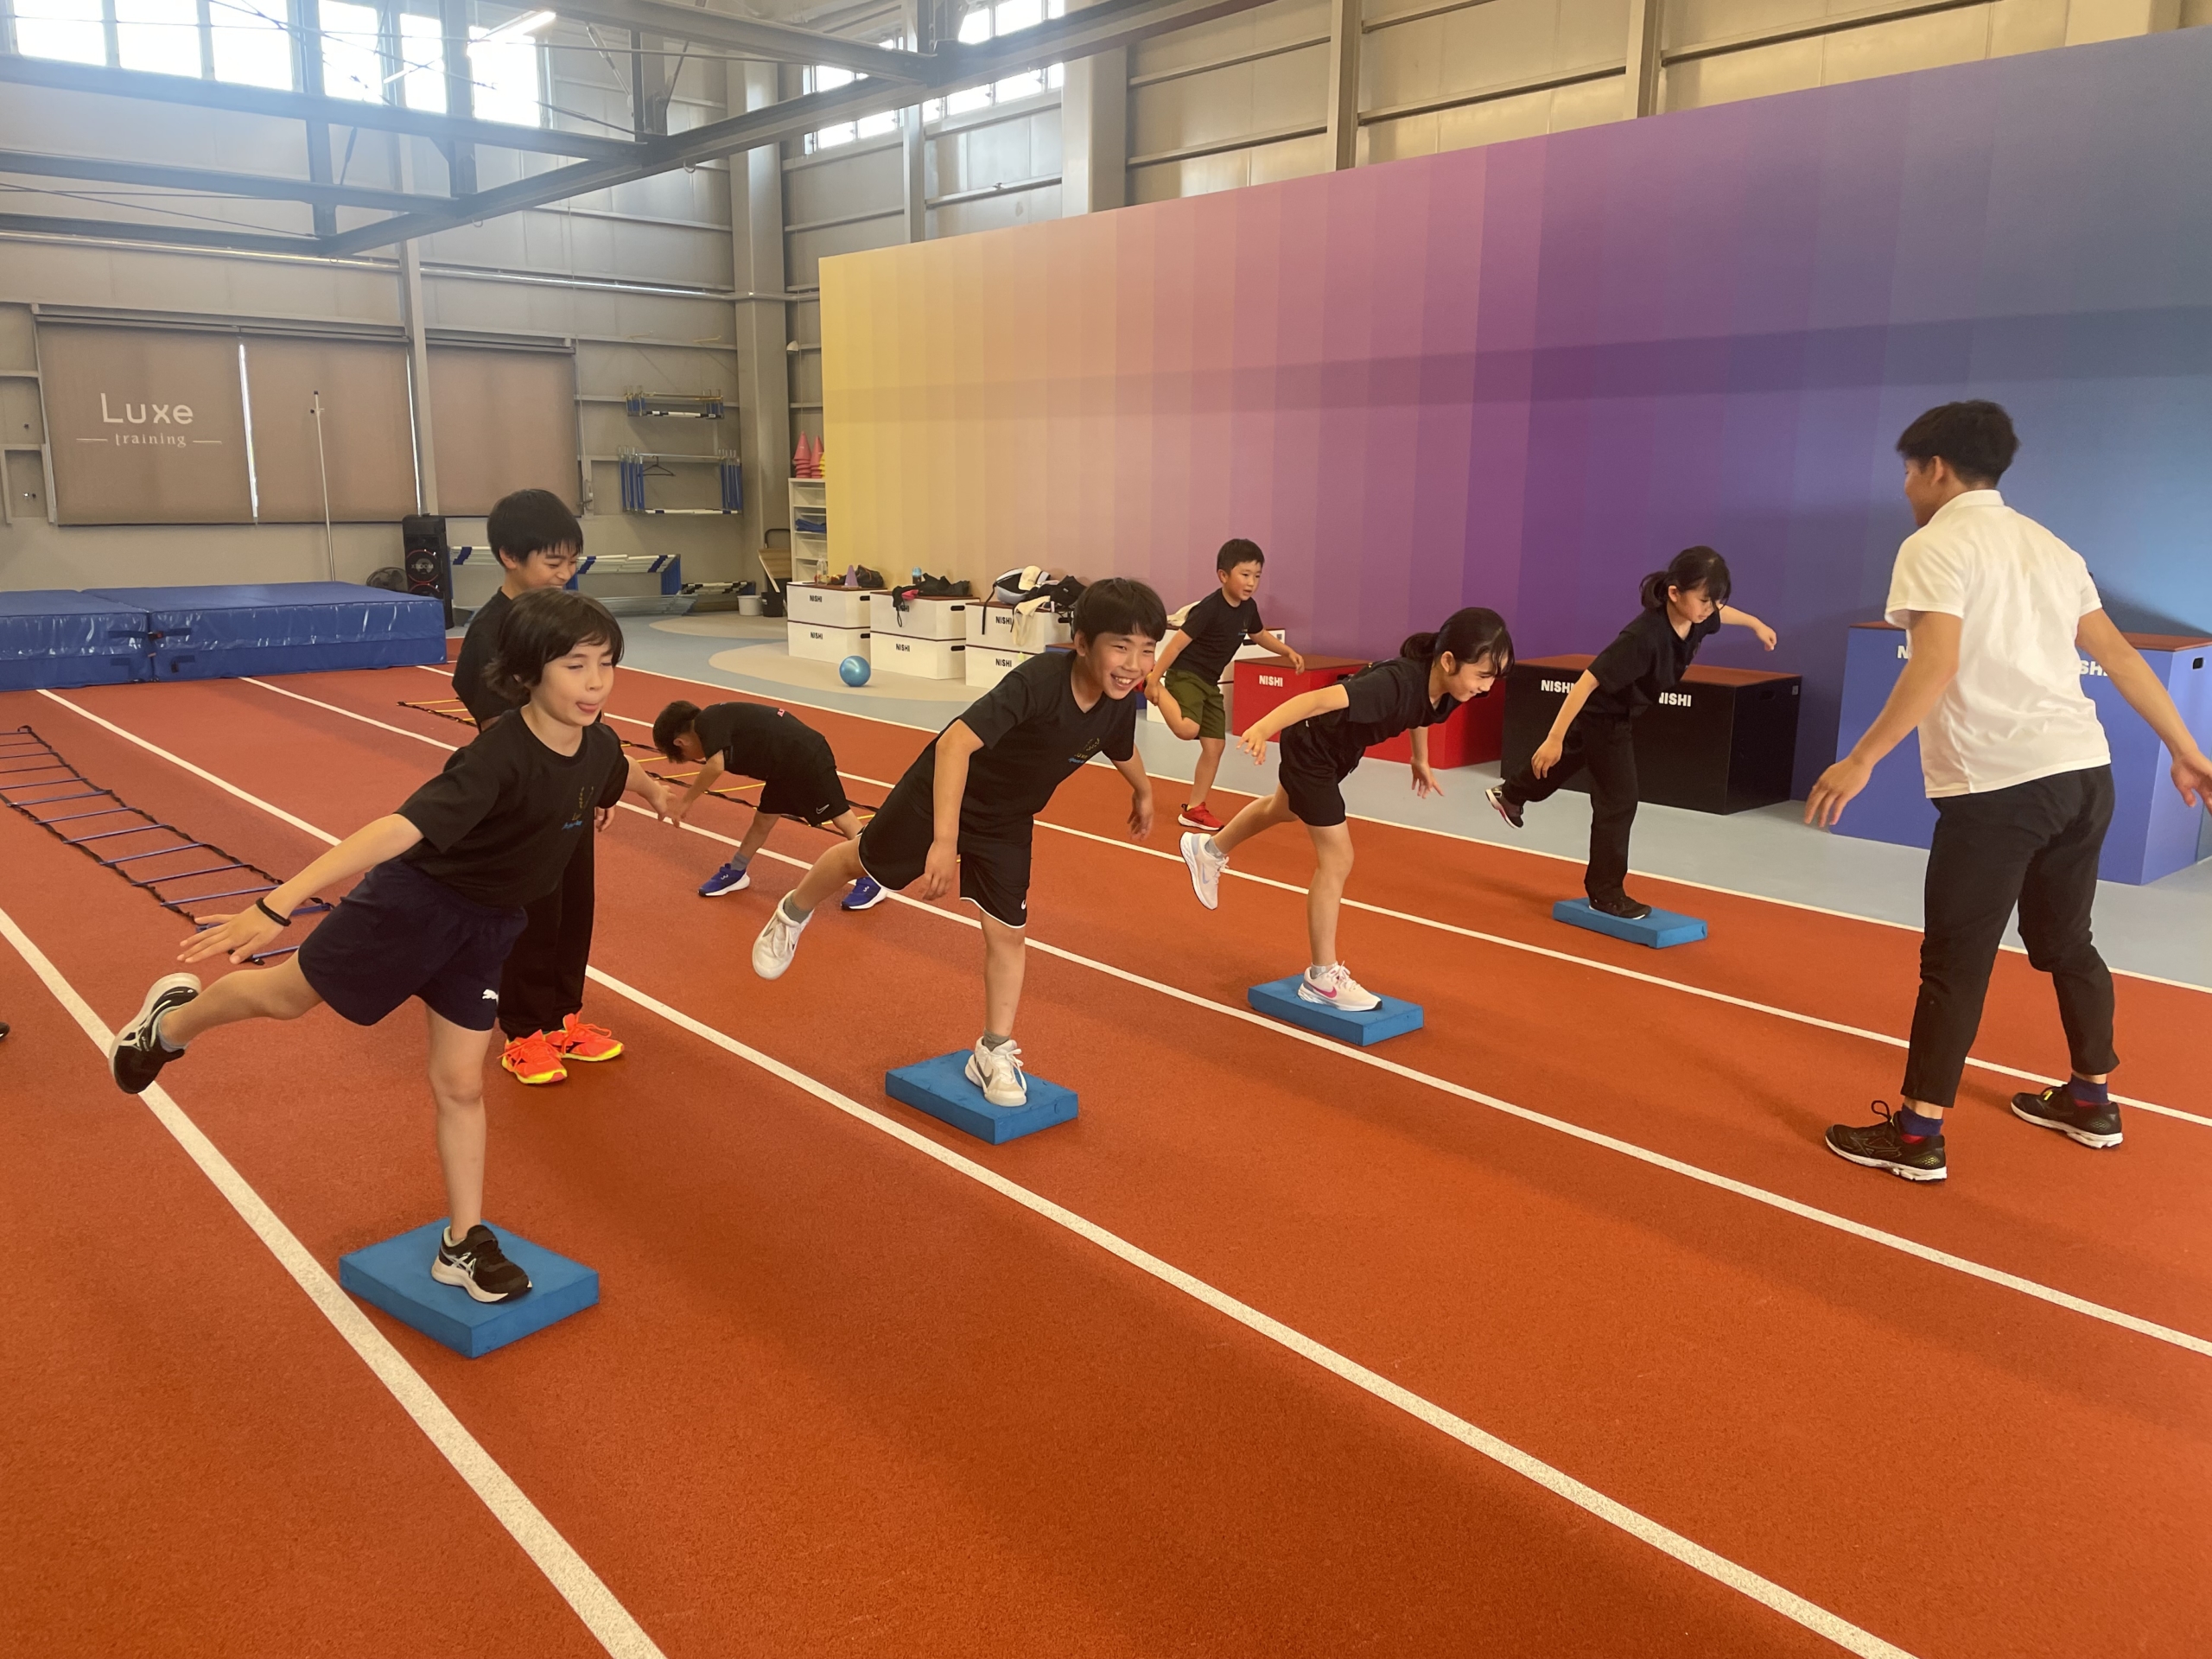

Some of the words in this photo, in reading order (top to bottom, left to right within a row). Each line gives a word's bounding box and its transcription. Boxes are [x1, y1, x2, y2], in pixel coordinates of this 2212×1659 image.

[100, 392, 194, 424] Luxe
[115, 433, 187, 448] training
[995, 616, 1013, 625] NISHI
[895, 643, 910, 652] NISHI
[995, 658, 1012, 667] NISHI
[1259, 674, 1283, 687] NISHI
